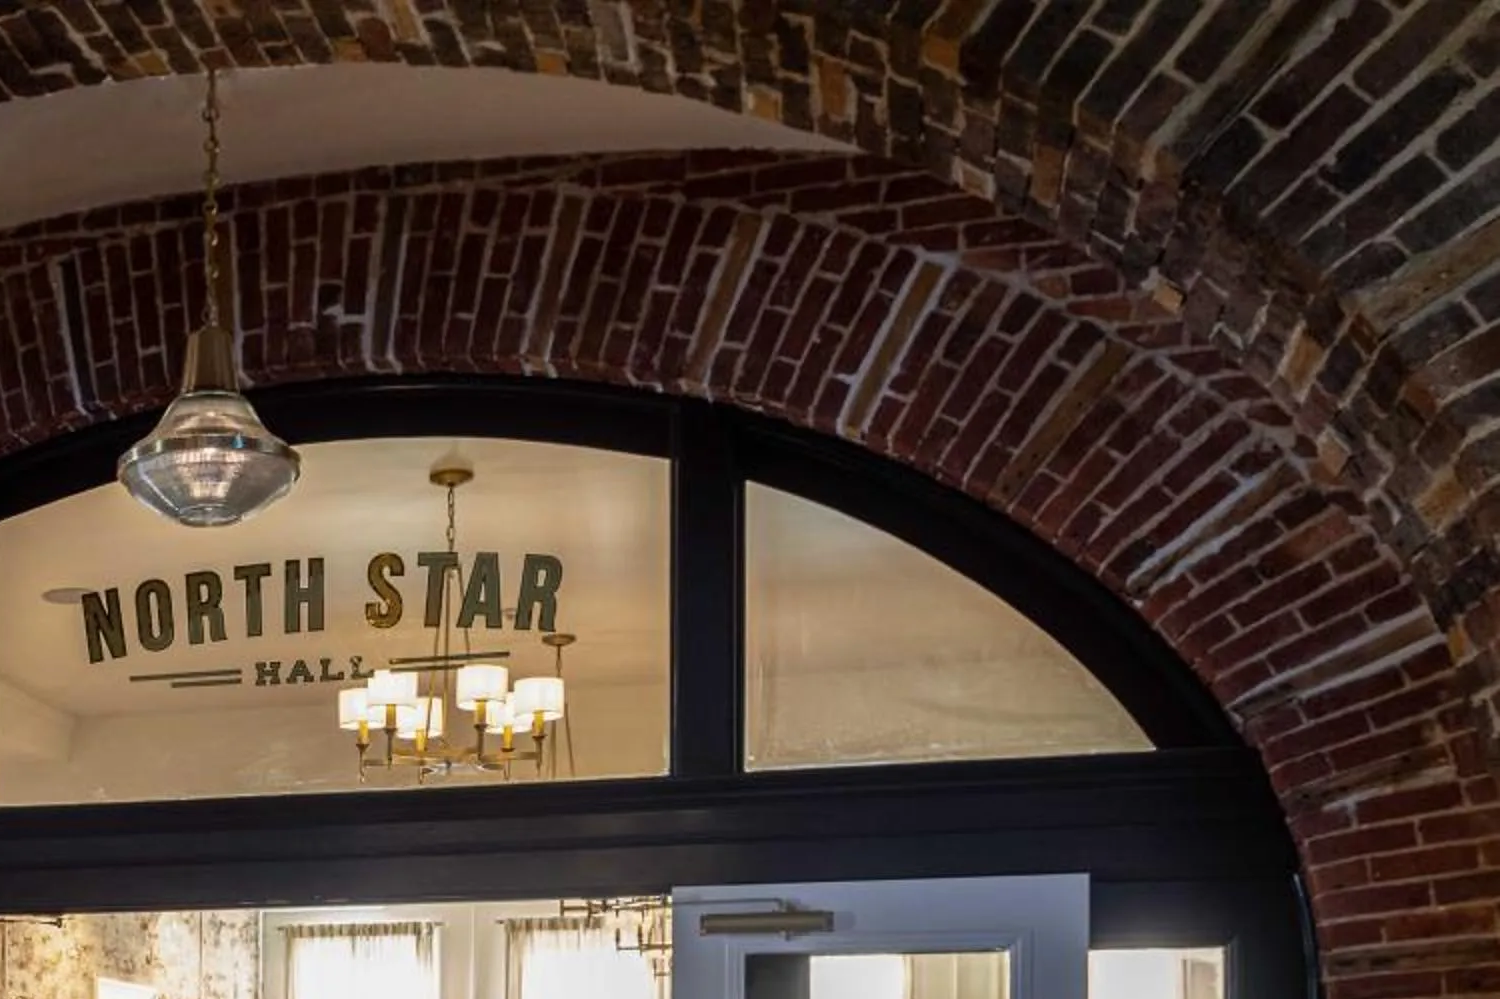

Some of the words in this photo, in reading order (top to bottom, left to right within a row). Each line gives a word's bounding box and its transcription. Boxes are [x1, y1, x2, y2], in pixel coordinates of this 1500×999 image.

[81, 557, 325, 664] NORTH
[365, 552, 564, 632] STAR
[255, 656, 375, 686] HALL
